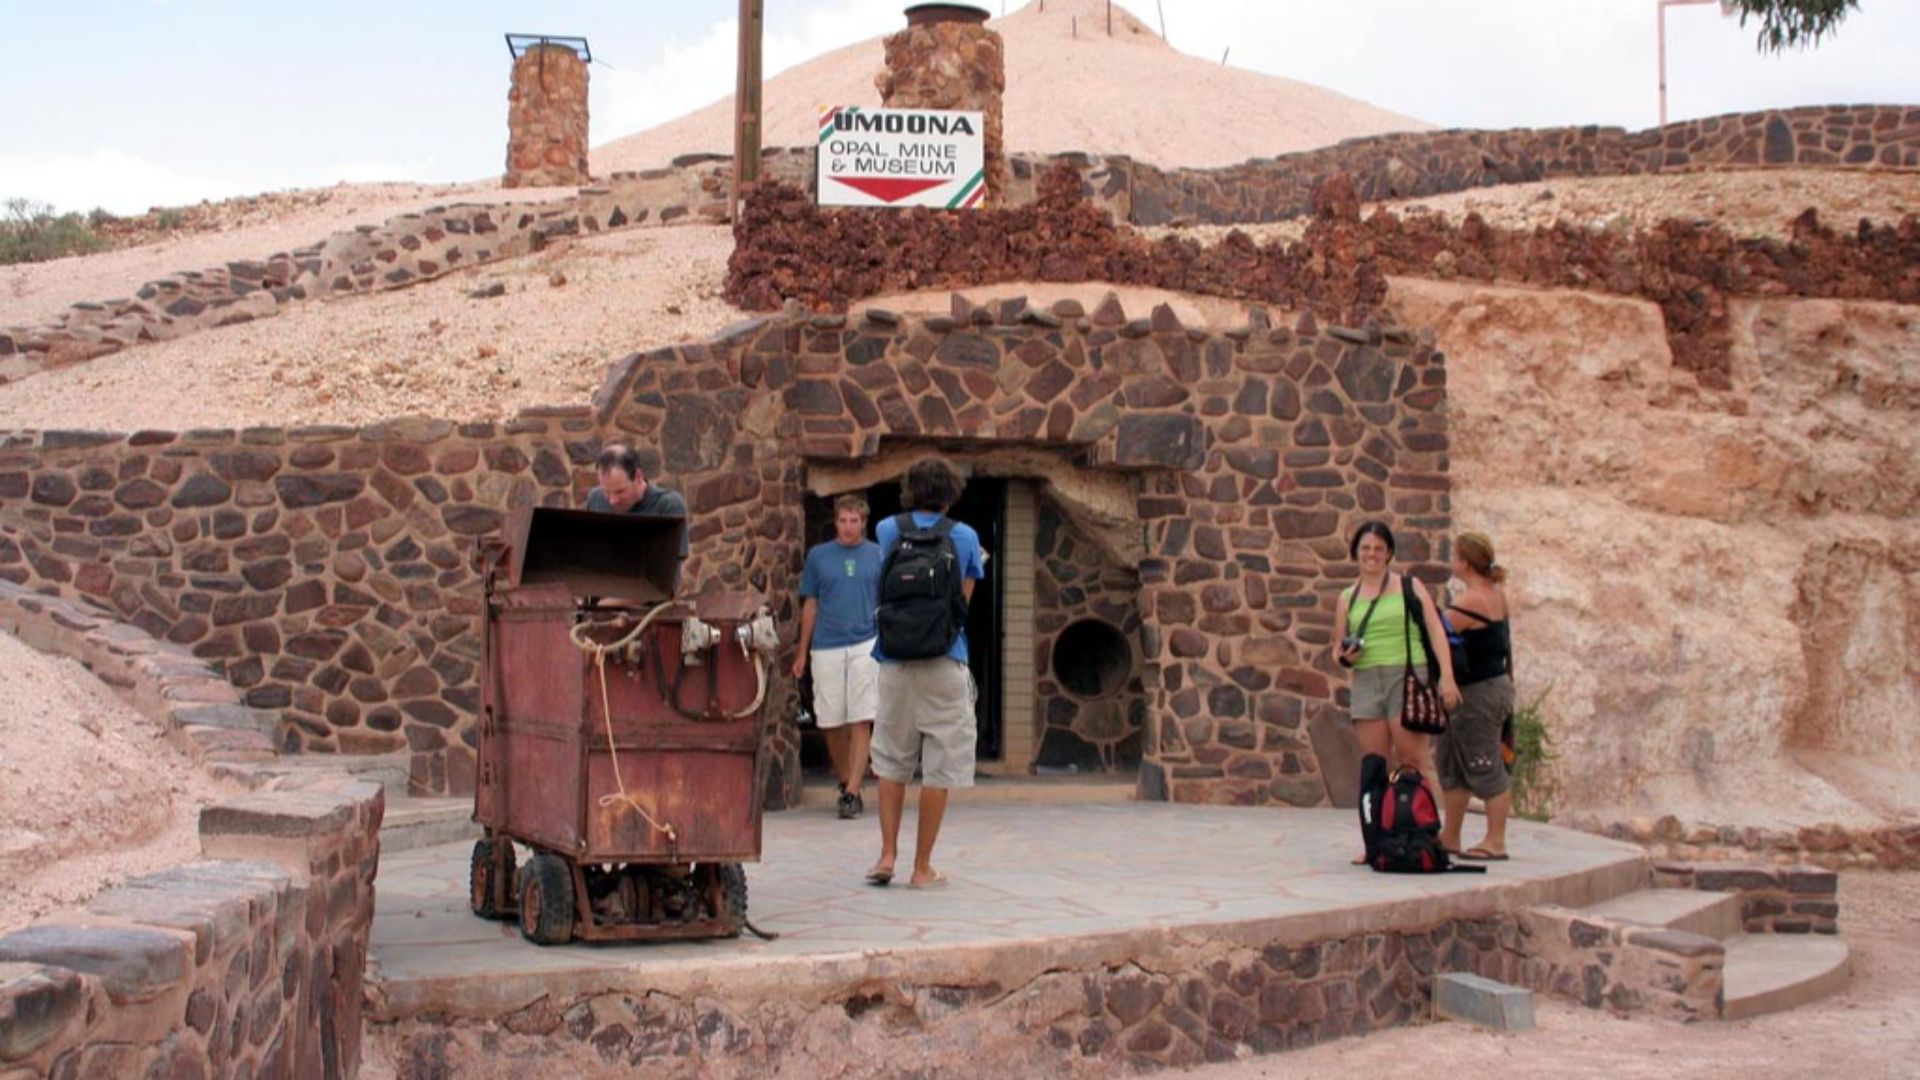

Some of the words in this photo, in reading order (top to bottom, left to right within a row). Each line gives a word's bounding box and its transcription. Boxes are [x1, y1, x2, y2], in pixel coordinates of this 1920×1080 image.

[834, 112, 974, 135] UMOONA
[830, 140, 888, 156] OPAL
[900, 143, 957, 159] MINE
[832, 159, 846, 173] &
[855, 158, 955, 175] MUSEUM
